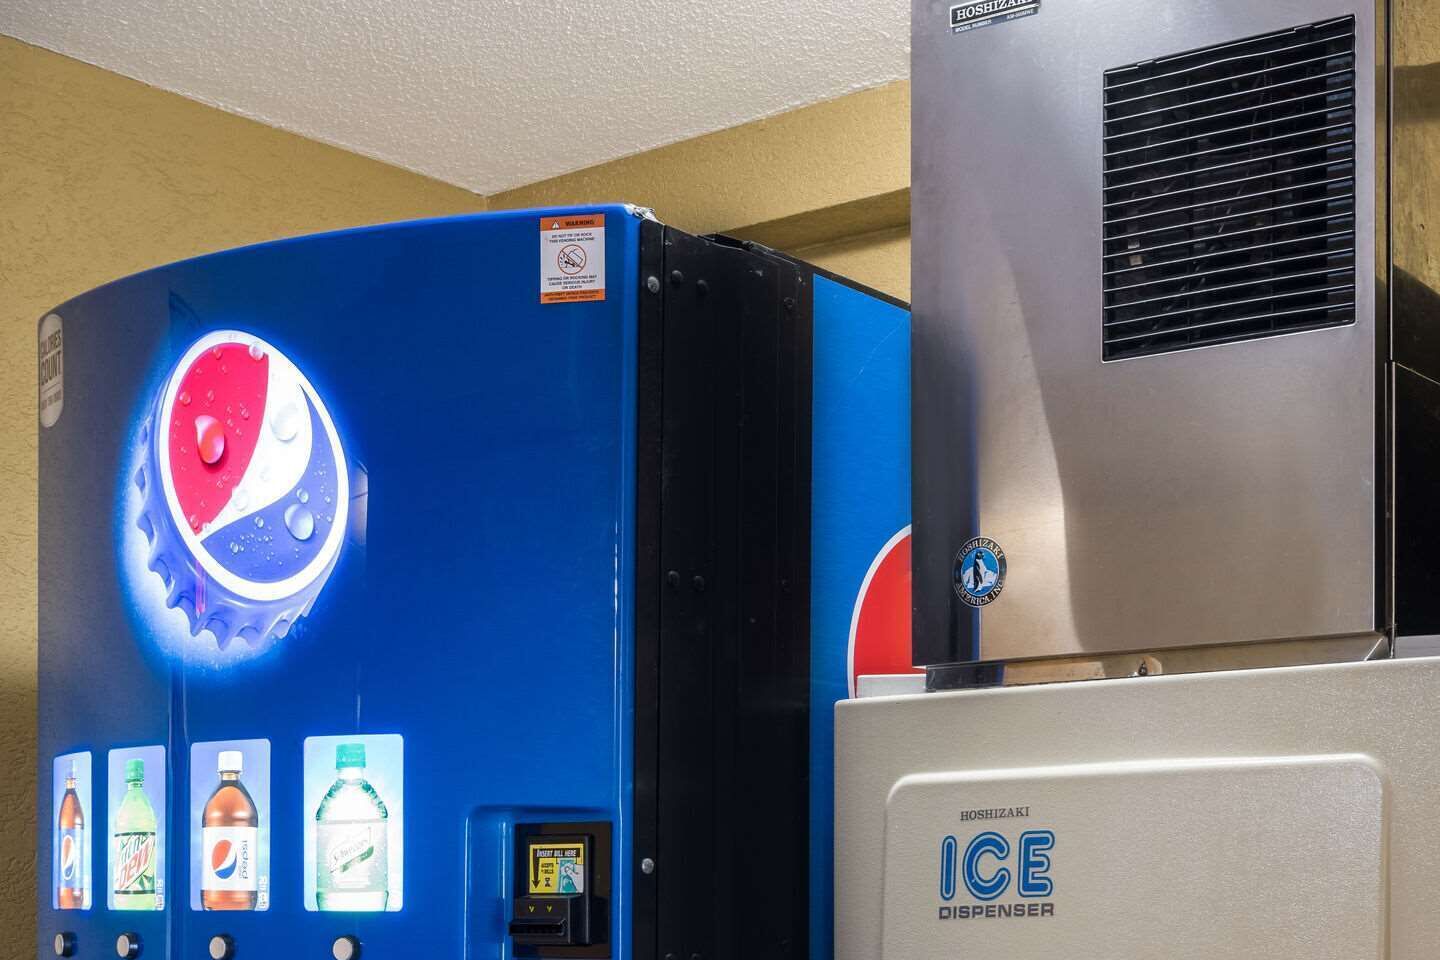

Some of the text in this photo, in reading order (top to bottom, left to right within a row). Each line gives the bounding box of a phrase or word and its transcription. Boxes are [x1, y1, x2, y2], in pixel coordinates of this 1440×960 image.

[956, 0, 1032, 20] HOSHIZA
[960, 806, 1030, 821] HOSHIZAKI
[940, 829, 1056, 901] ICE
[939, 903, 1054, 920] DISPENSER
